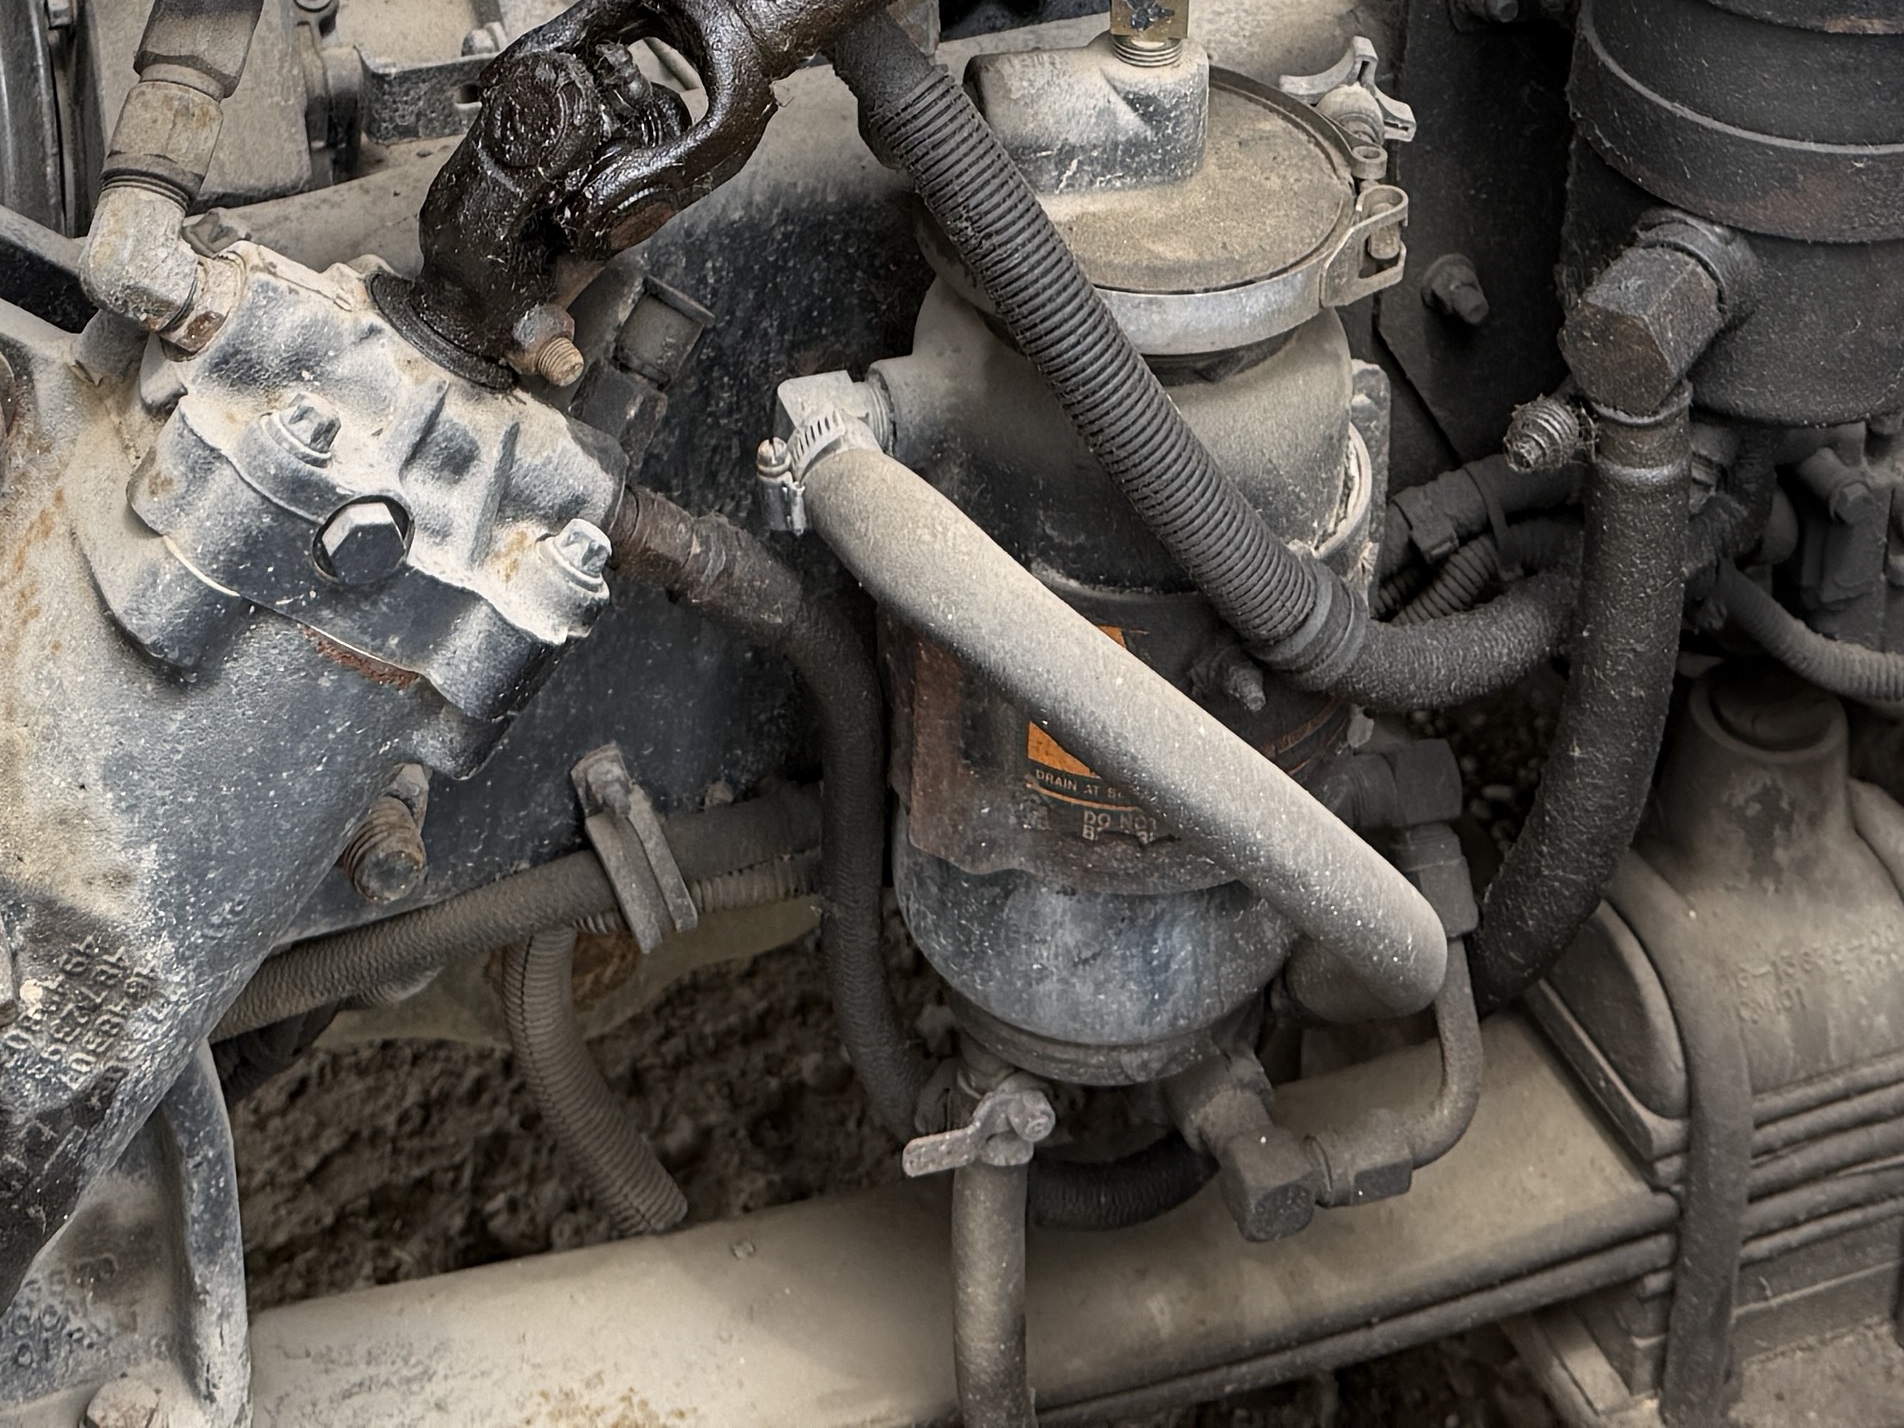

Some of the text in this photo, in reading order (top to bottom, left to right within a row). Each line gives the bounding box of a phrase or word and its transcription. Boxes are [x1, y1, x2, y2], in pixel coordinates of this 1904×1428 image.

[1035, 769, 1078, 792] DRAIN
[1083, 784, 1100, 797] AT
[1083, 810, 1111, 830] DO
